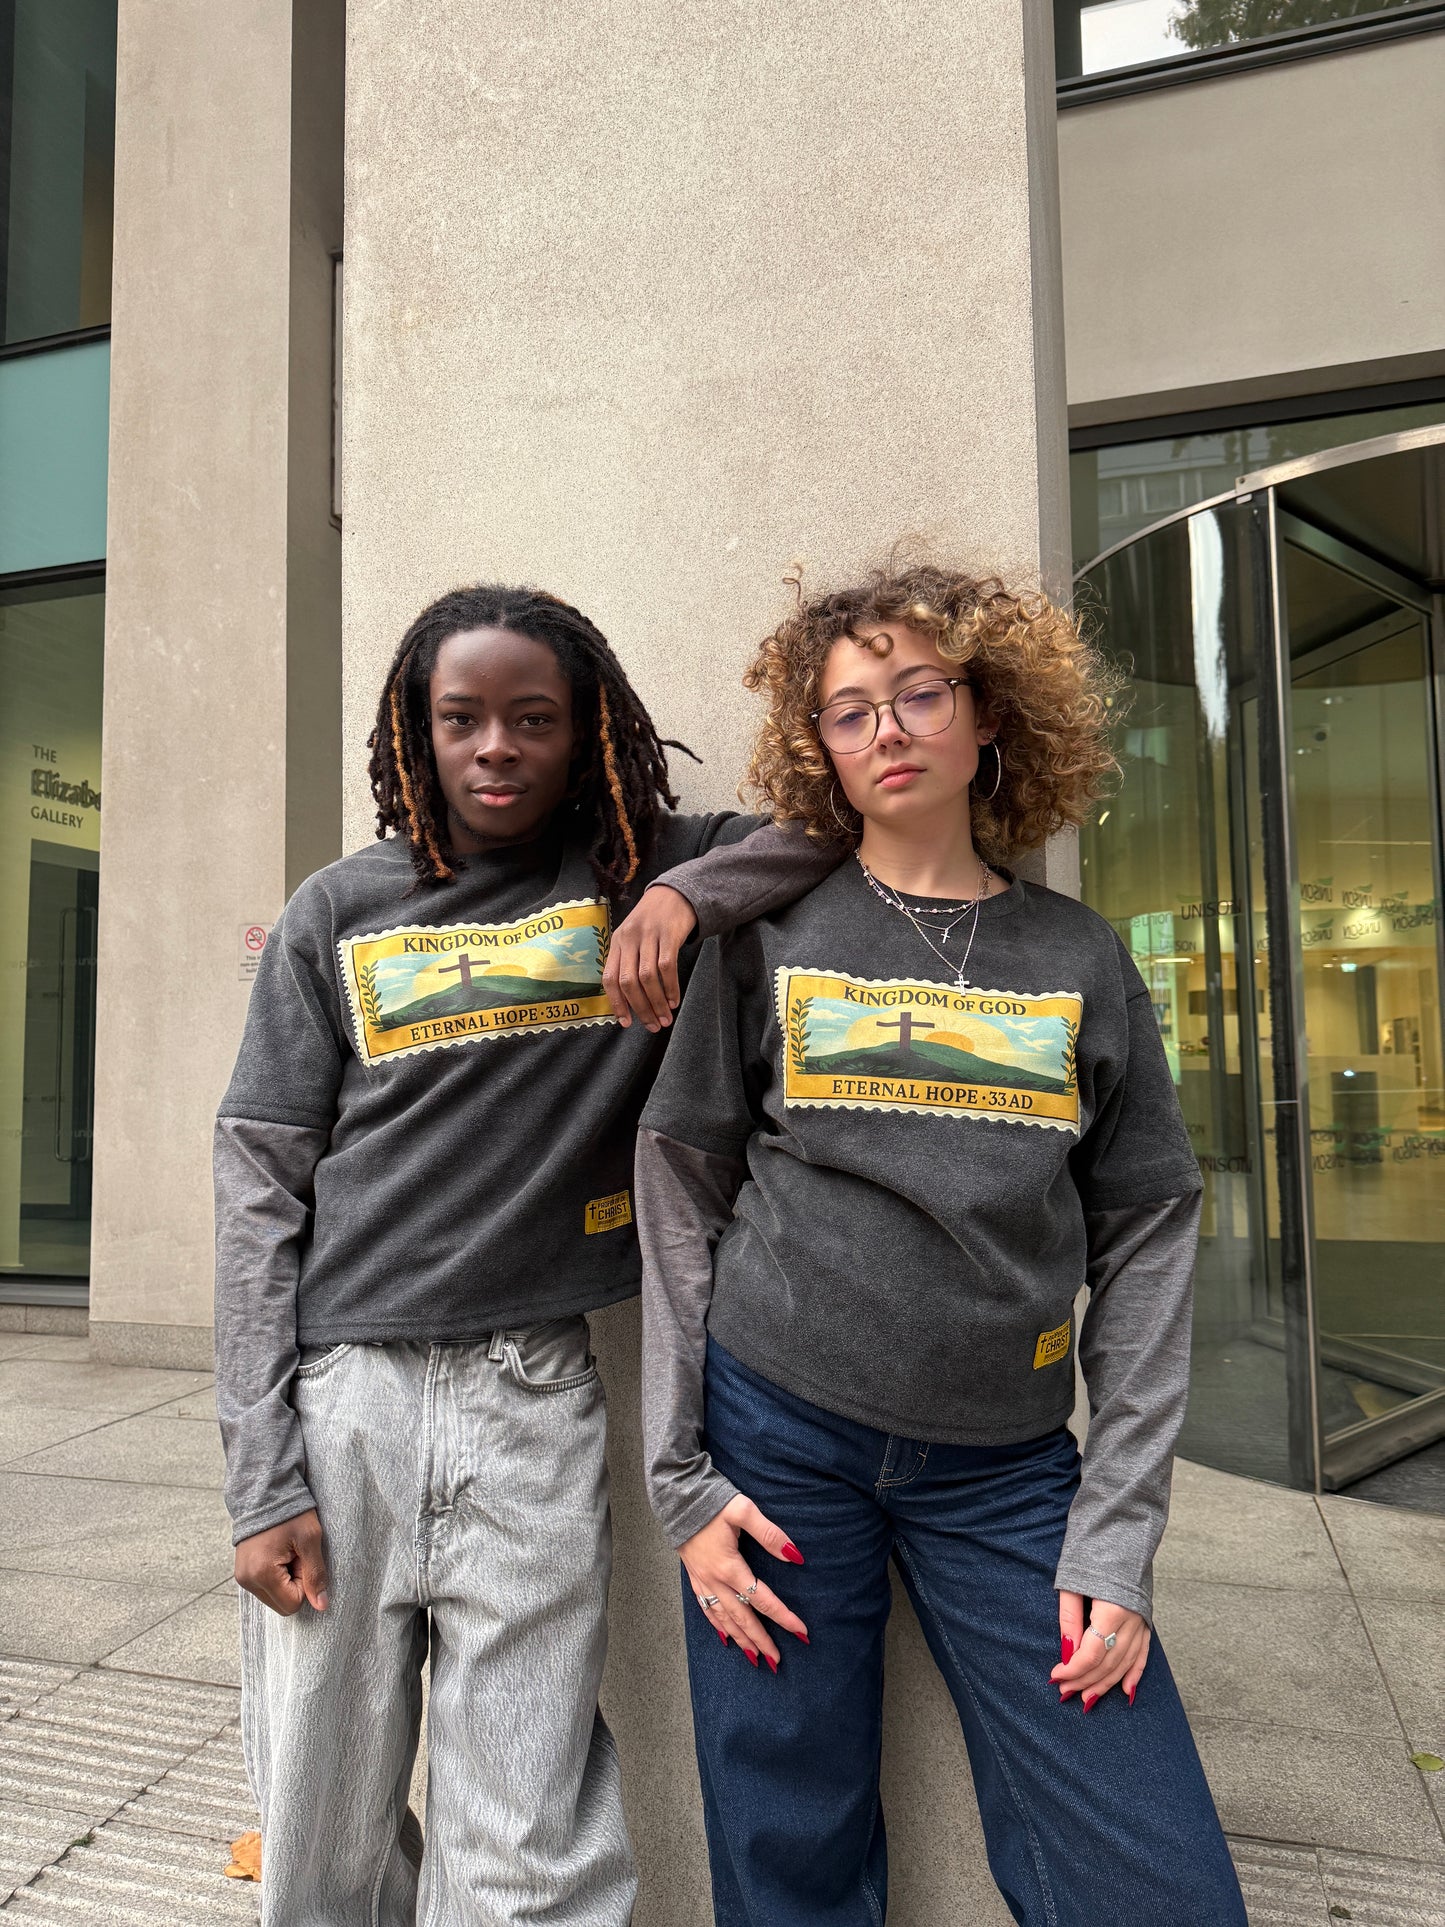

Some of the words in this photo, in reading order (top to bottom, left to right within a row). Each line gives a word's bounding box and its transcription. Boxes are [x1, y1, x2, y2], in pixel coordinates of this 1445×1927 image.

[32, 744, 57, 764] THE
[30, 806, 84, 828] GALLERY
[403, 932, 499, 953] KINGDOM
[503, 932, 522, 947] OF
[524, 914, 565, 939] GOD
[843, 986, 949, 1008] KINGDOM
[953, 999, 975, 1011] OF
[979, 999, 1027, 1016] GOD
[410, 1014, 489, 1042] ETERNAL
[832, 1079, 920, 1100] ETERNAL
[1200, 1155, 1253, 1174] NISON
[598, 1202, 627, 1220] CHRIST
